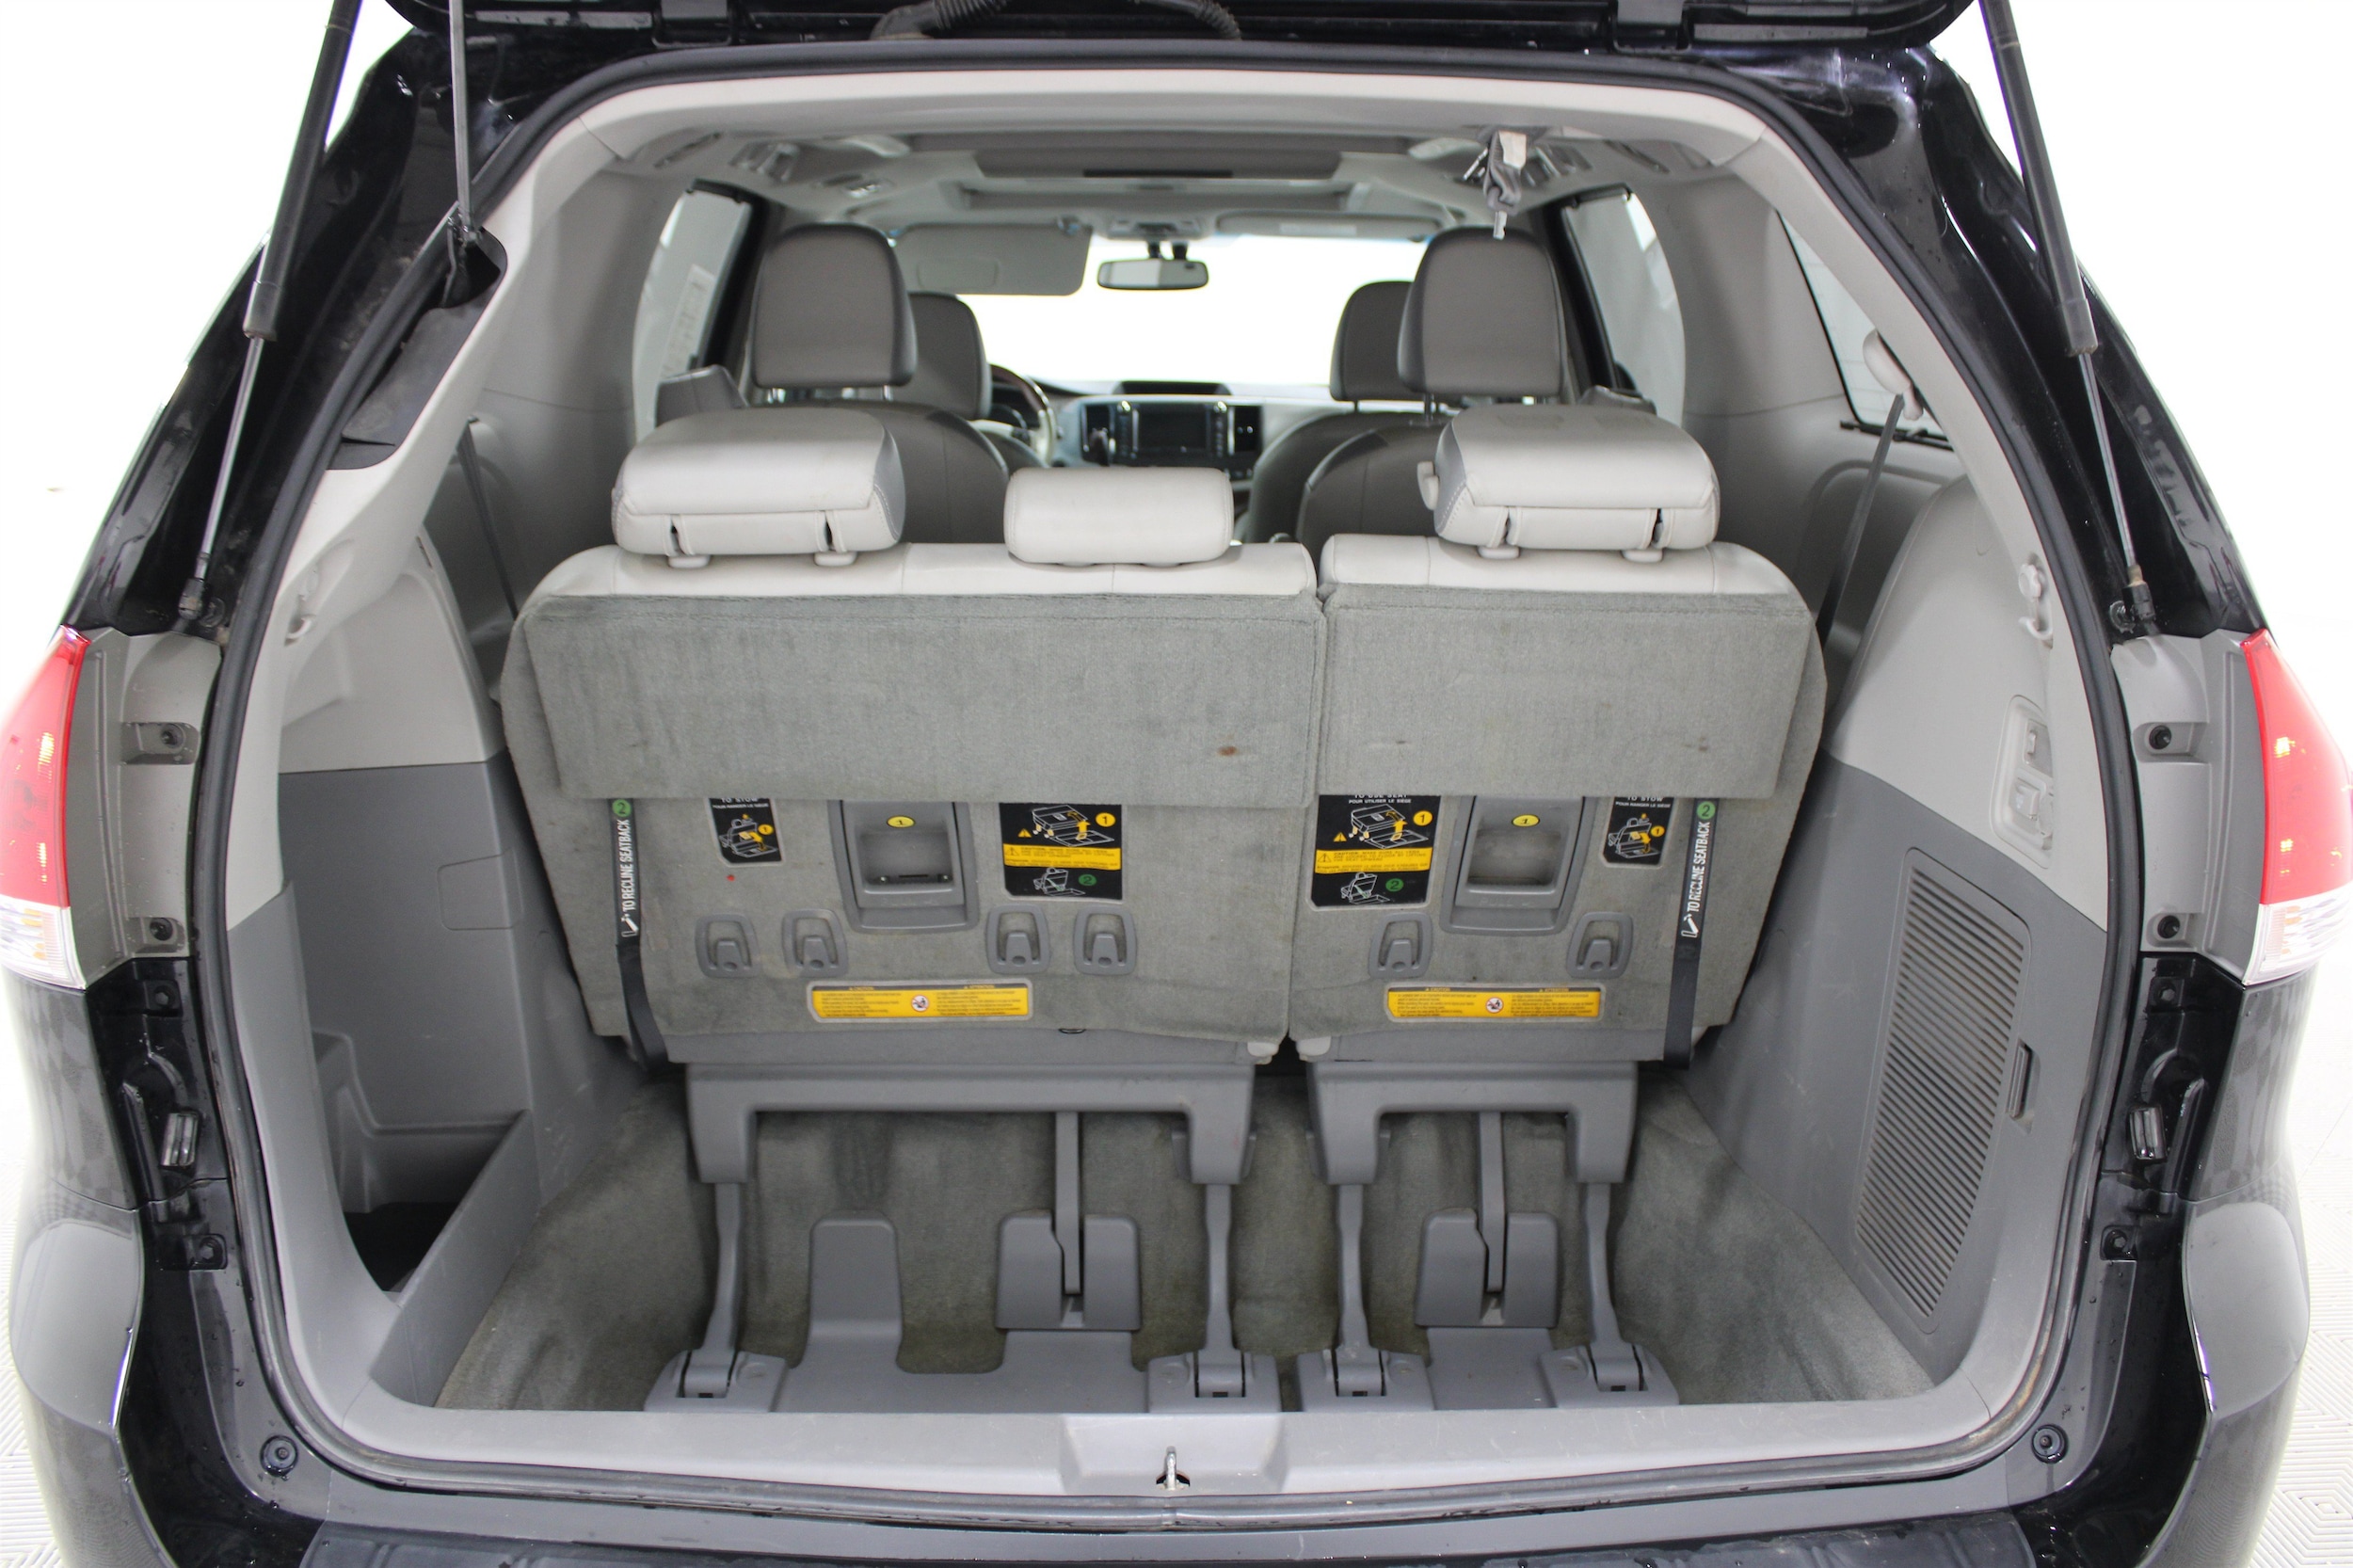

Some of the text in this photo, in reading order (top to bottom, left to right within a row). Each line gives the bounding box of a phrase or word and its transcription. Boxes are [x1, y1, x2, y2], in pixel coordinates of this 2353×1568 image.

[1701, 804, 1710, 817] 2
[617, 820, 636, 912] TO RECLINE SEATBACK
[1687, 822, 1710, 912] TO RECLINE SEATBACK
